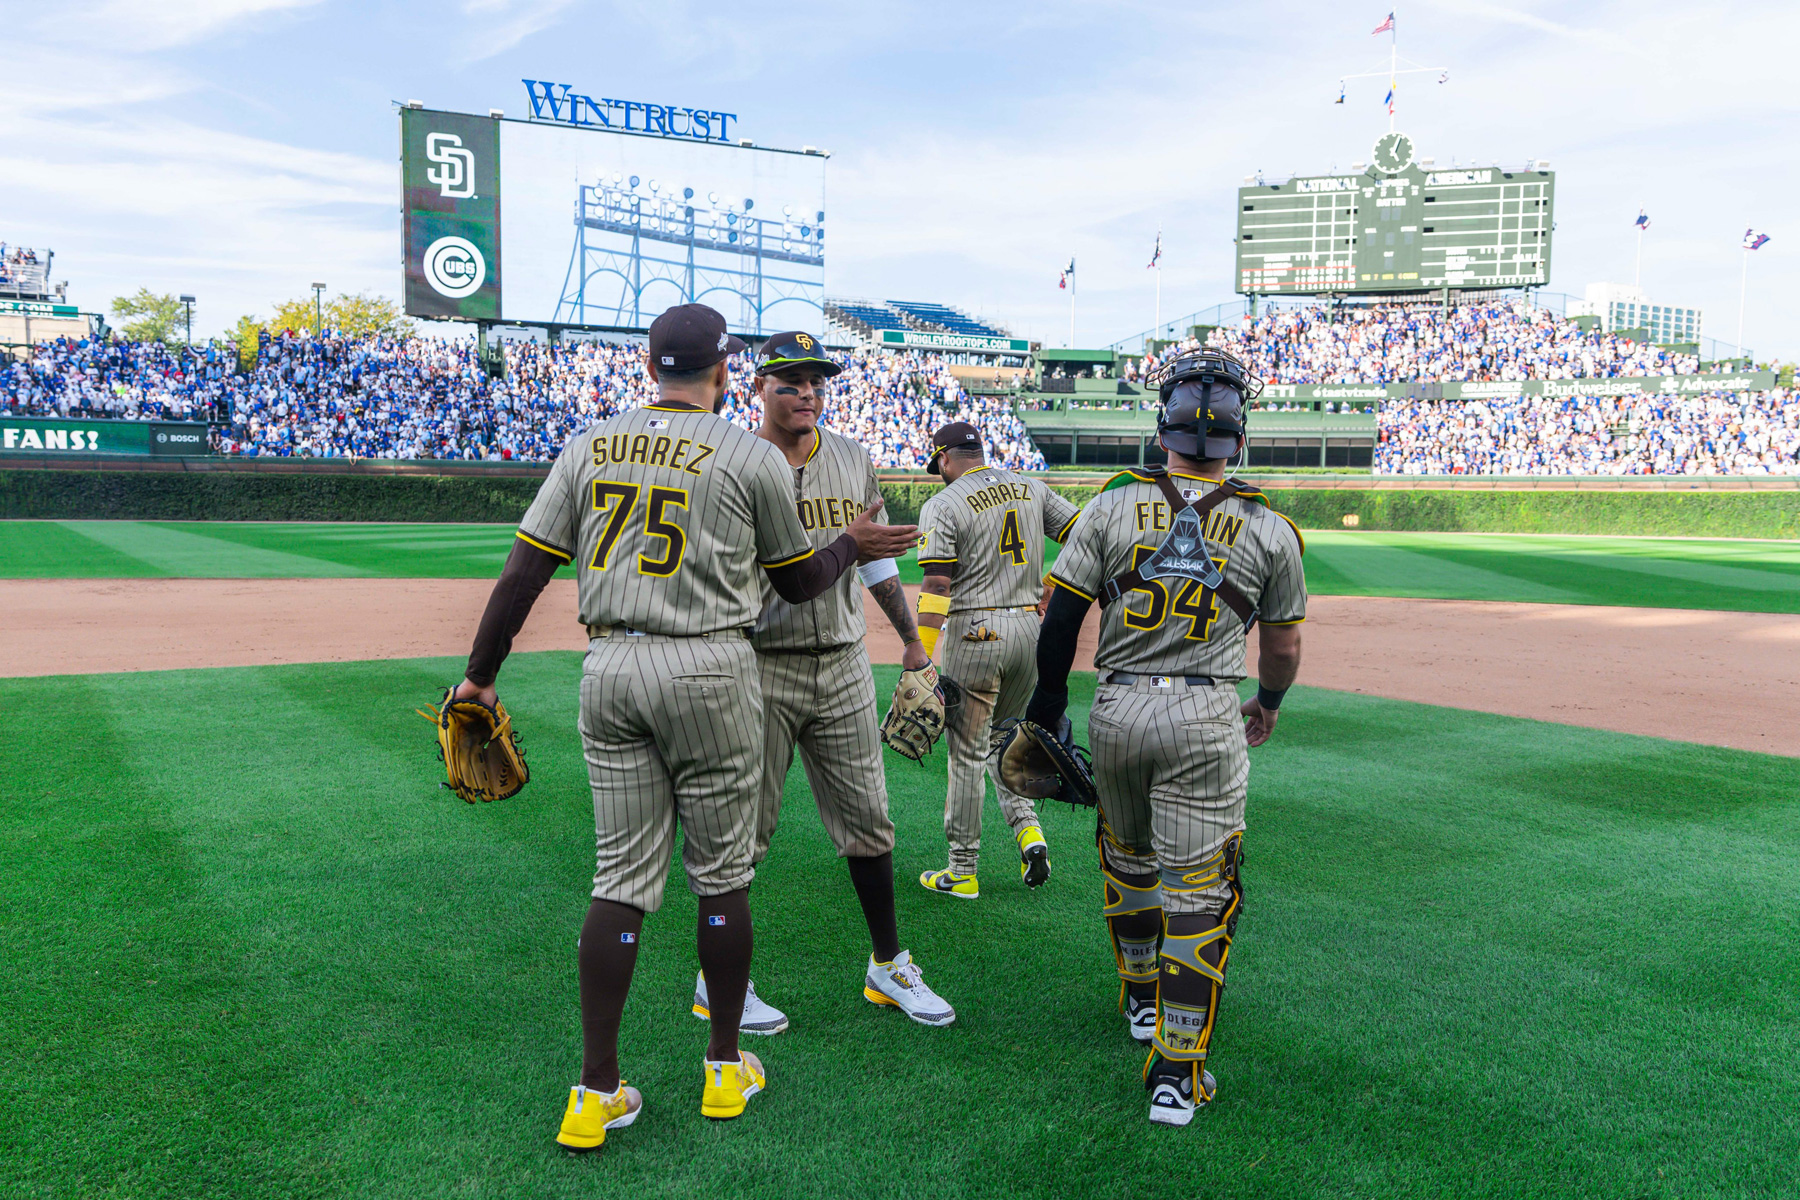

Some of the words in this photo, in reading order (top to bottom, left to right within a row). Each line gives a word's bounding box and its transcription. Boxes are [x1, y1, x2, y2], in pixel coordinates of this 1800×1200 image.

[521, 78, 737, 142] WINTRUST
[1296, 177, 1360, 193] NATIONAL
[1424, 170, 1492, 186] AMERICAN
[1681, 377, 1751, 391] Advocate
[3, 428, 99, 451] FANS!
[170, 434, 200, 443] BOSCH
[592, 433, 715, 477] SUAREZ
[966, 482, 1032, 515] ARRAEZ
[588, 479, 689, 579] 75
[999, 508, 1029, 567] 4
